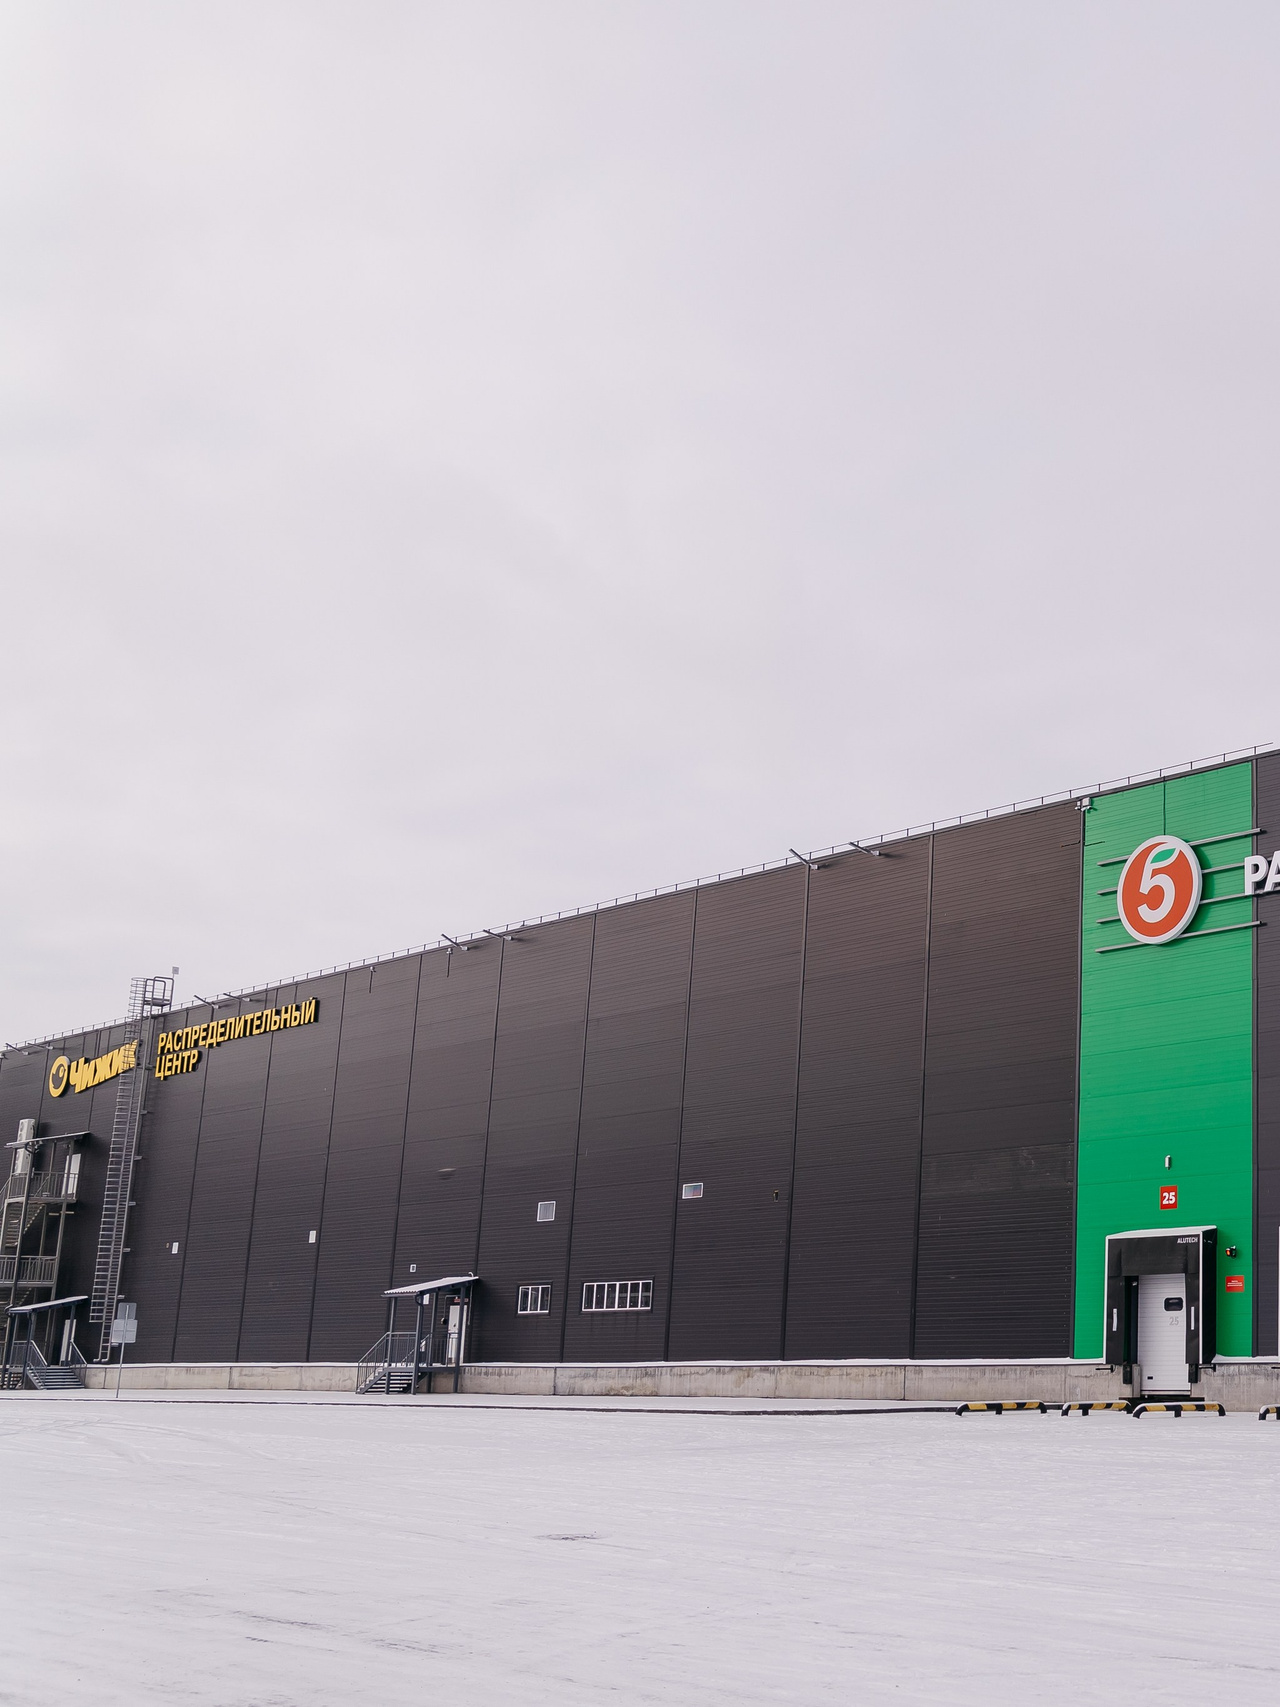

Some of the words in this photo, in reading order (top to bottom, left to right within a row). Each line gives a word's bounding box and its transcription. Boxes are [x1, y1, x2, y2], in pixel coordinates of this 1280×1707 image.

[157, 997, 317, 1055] РАСПРЕДЕЛИТЕЛЬНЫЙ
[155, 1050, 199, 1081] ЦЕНТР
[1162, 1191, 1176, 1205] 25
[1177, 1236, 1199, 1245] ALUTECH
[1169, 1316, 1180, 1326] 25
